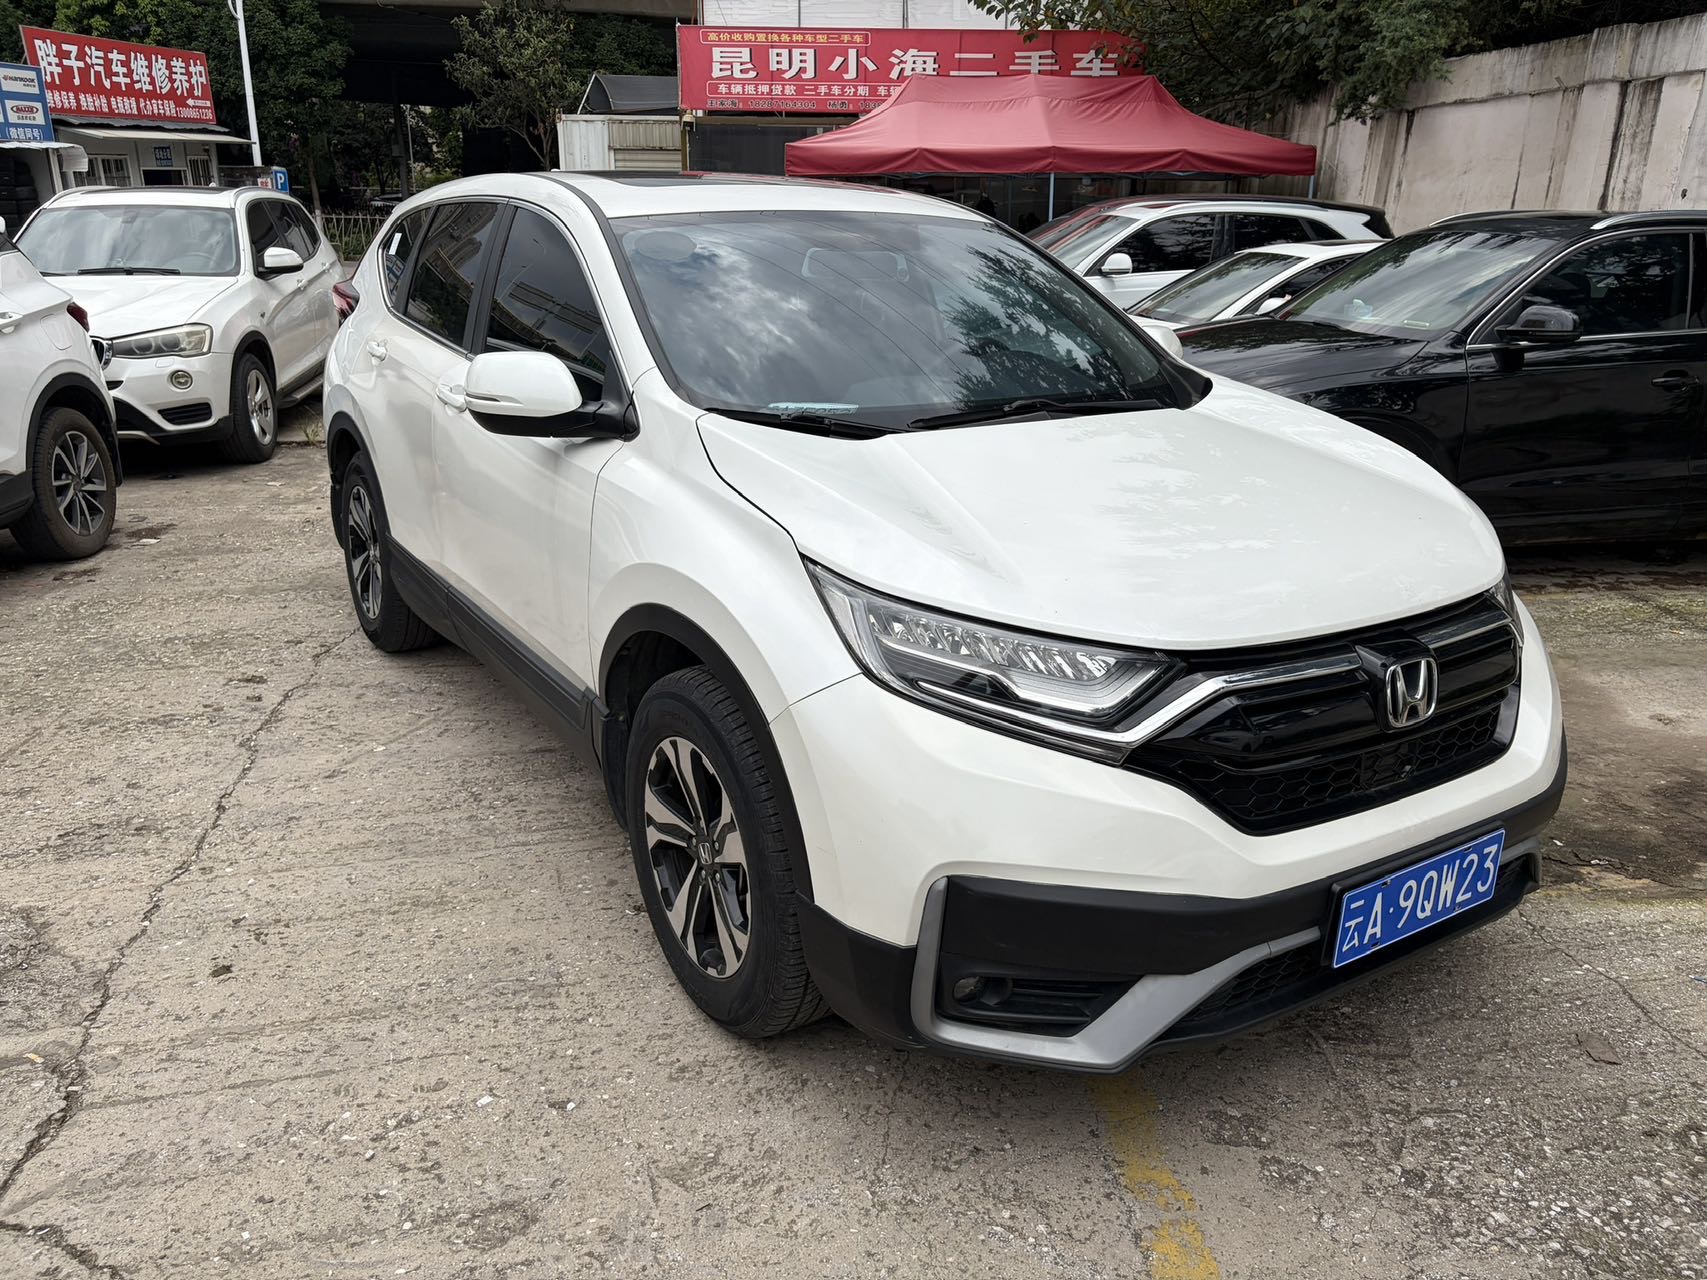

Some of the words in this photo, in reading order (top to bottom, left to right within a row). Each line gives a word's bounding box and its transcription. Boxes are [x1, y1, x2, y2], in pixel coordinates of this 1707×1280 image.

[707, 32, 864, 43] 高价收购置换各种车型二手车
[34, 39, 207, 97] 胖子汽车维修养护
[711, 47, 1119, 80] 昆明小海二手车
[718, 84, 797, 95] 车辆抵押贷款
[804, 84, 869, 96] 二手车分期
[748, 100, 816, 109] 18287164304
[276, 172, 285, 189] P
